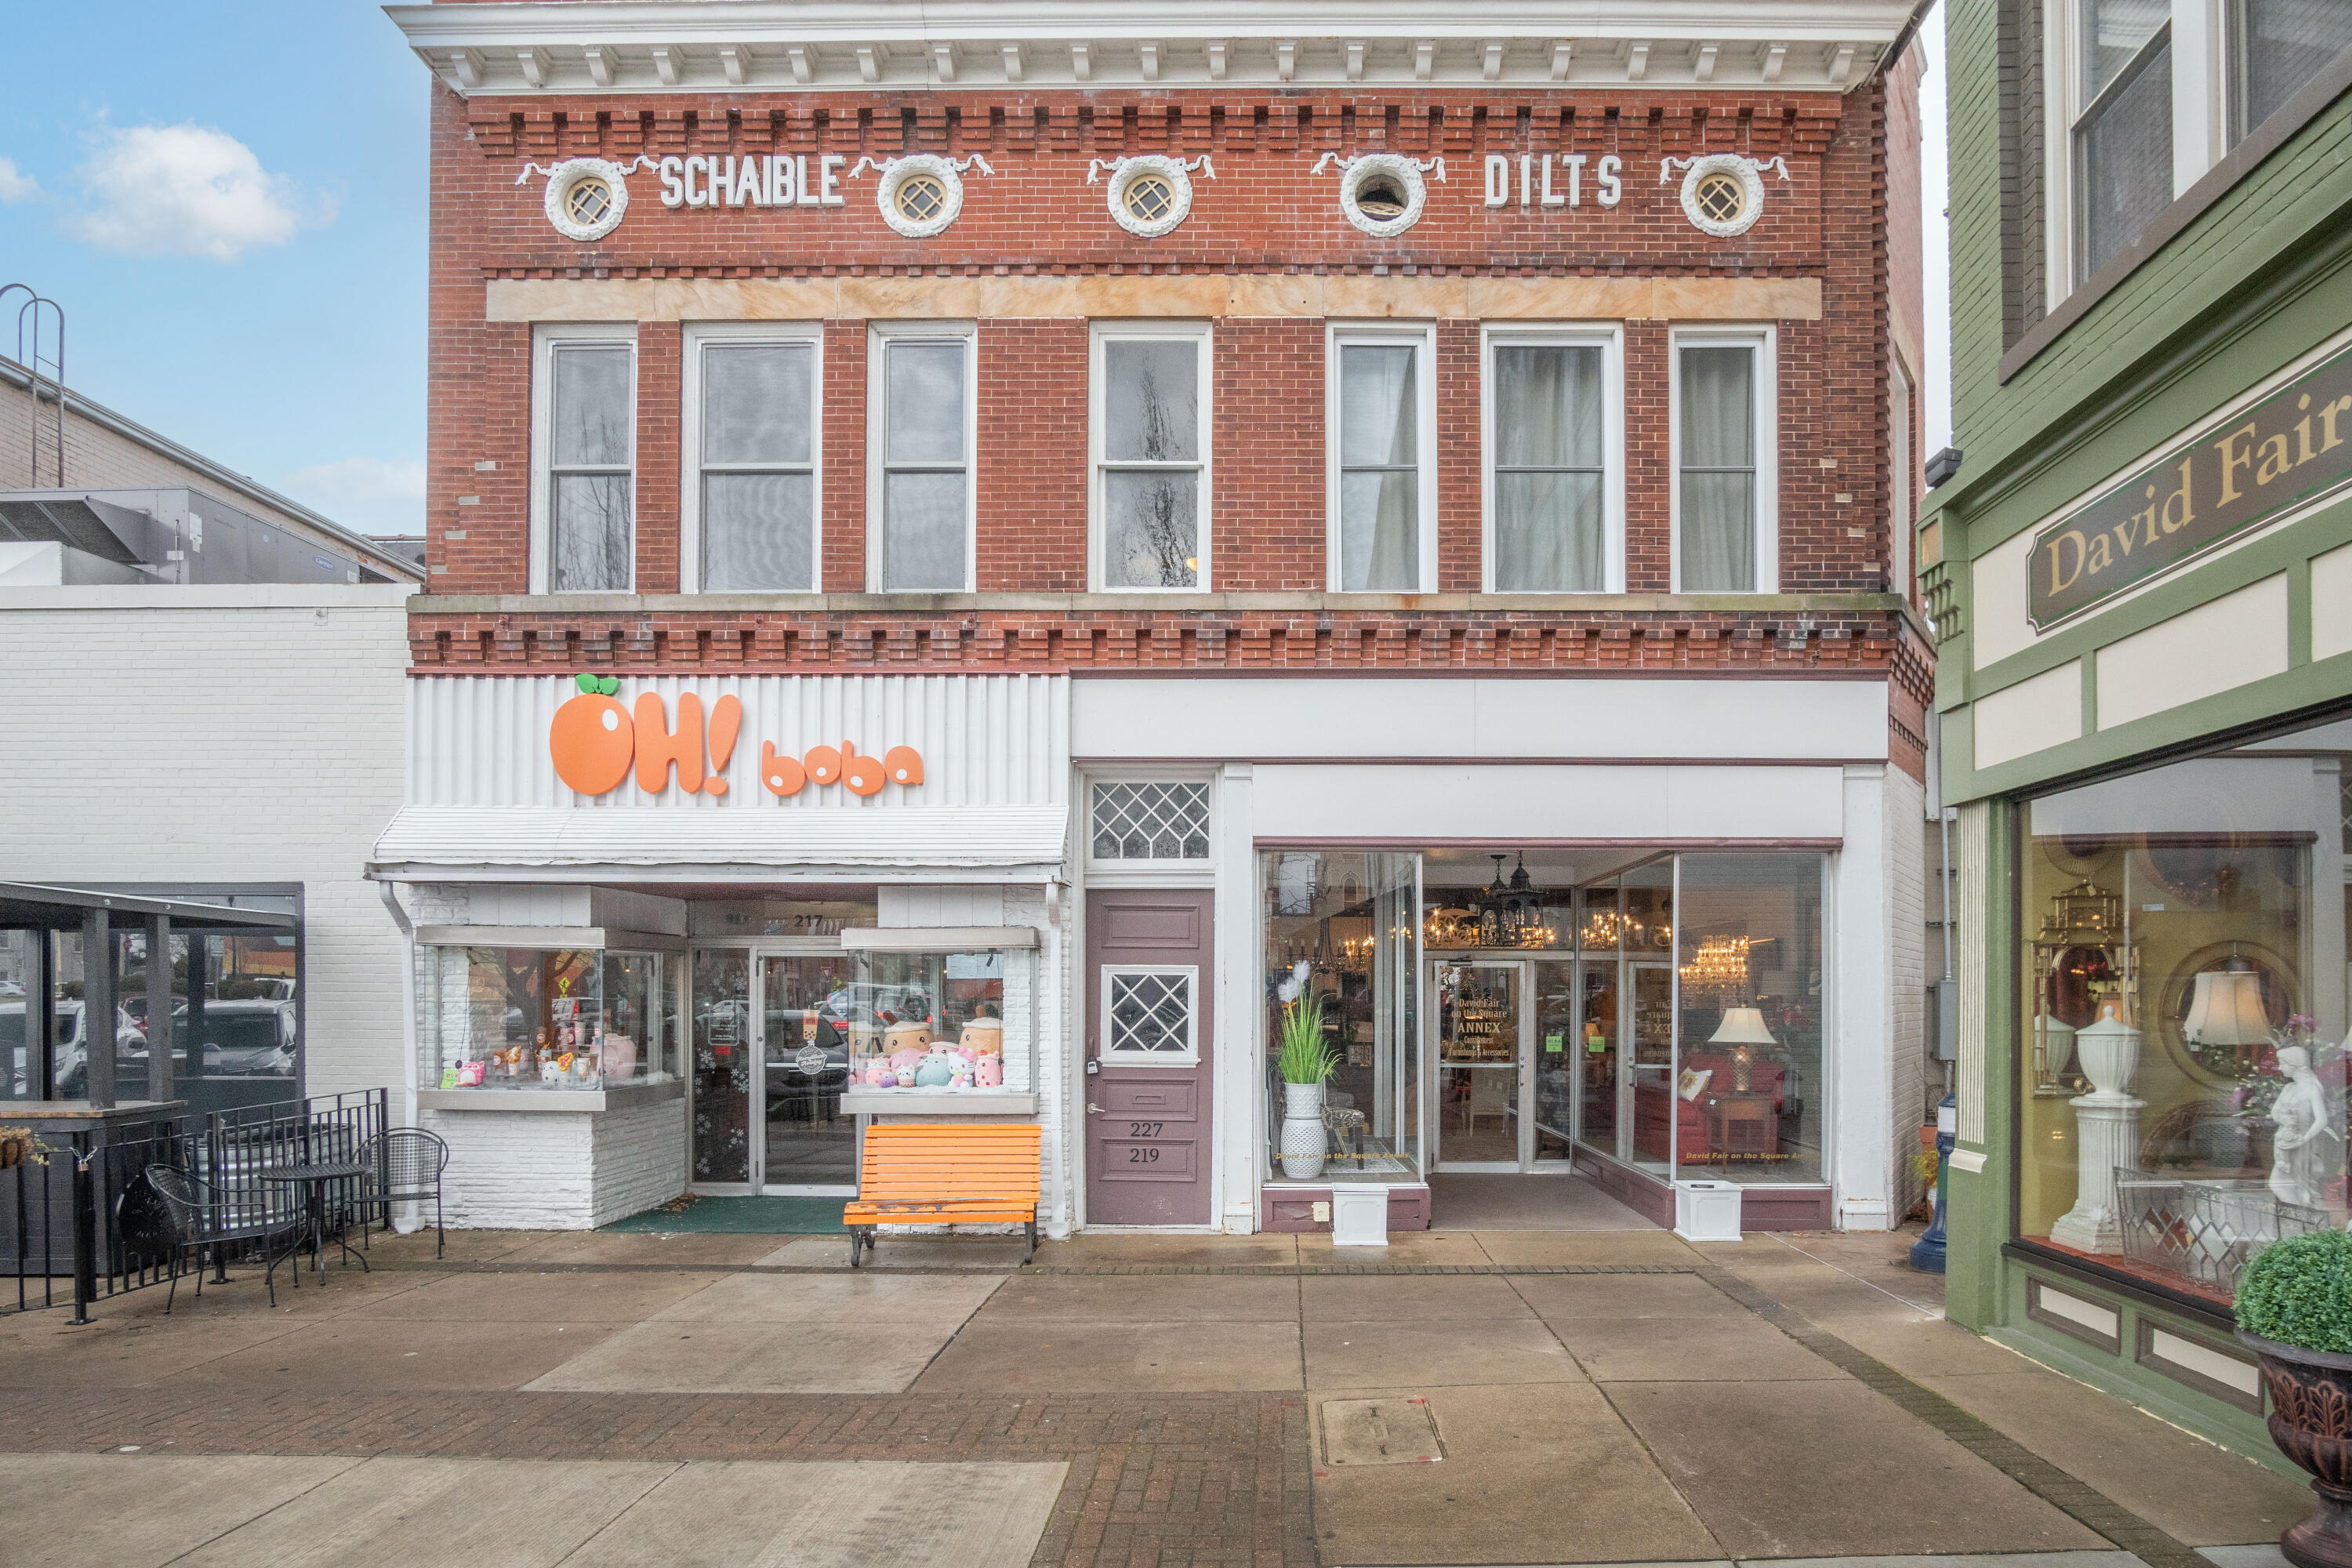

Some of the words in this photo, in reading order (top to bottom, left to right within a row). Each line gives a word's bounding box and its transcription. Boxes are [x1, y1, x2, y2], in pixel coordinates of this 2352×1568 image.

[660, 155, 845, 209] SCHAIBLE
[1484, 154, 1622, 209] DILTS
[2045, 456, 2196, 597] David
[2213, 393, 2352, 509] Fair
[550, 691, 743, 796] OH!
[762, 739, 924, 796] boba
[794, 914, 823, 927] 217
[1459, 999, 1481, 1007] David
[1483, 999, 1500, 1007] Fair
[1479, 1010, 1507, 1018] Square
[1458, 1022, 1501, 1033] ANNEX
[1131, 1123, 1163, 1137] 227
[1130, 1149, 1160, 1163] 219
